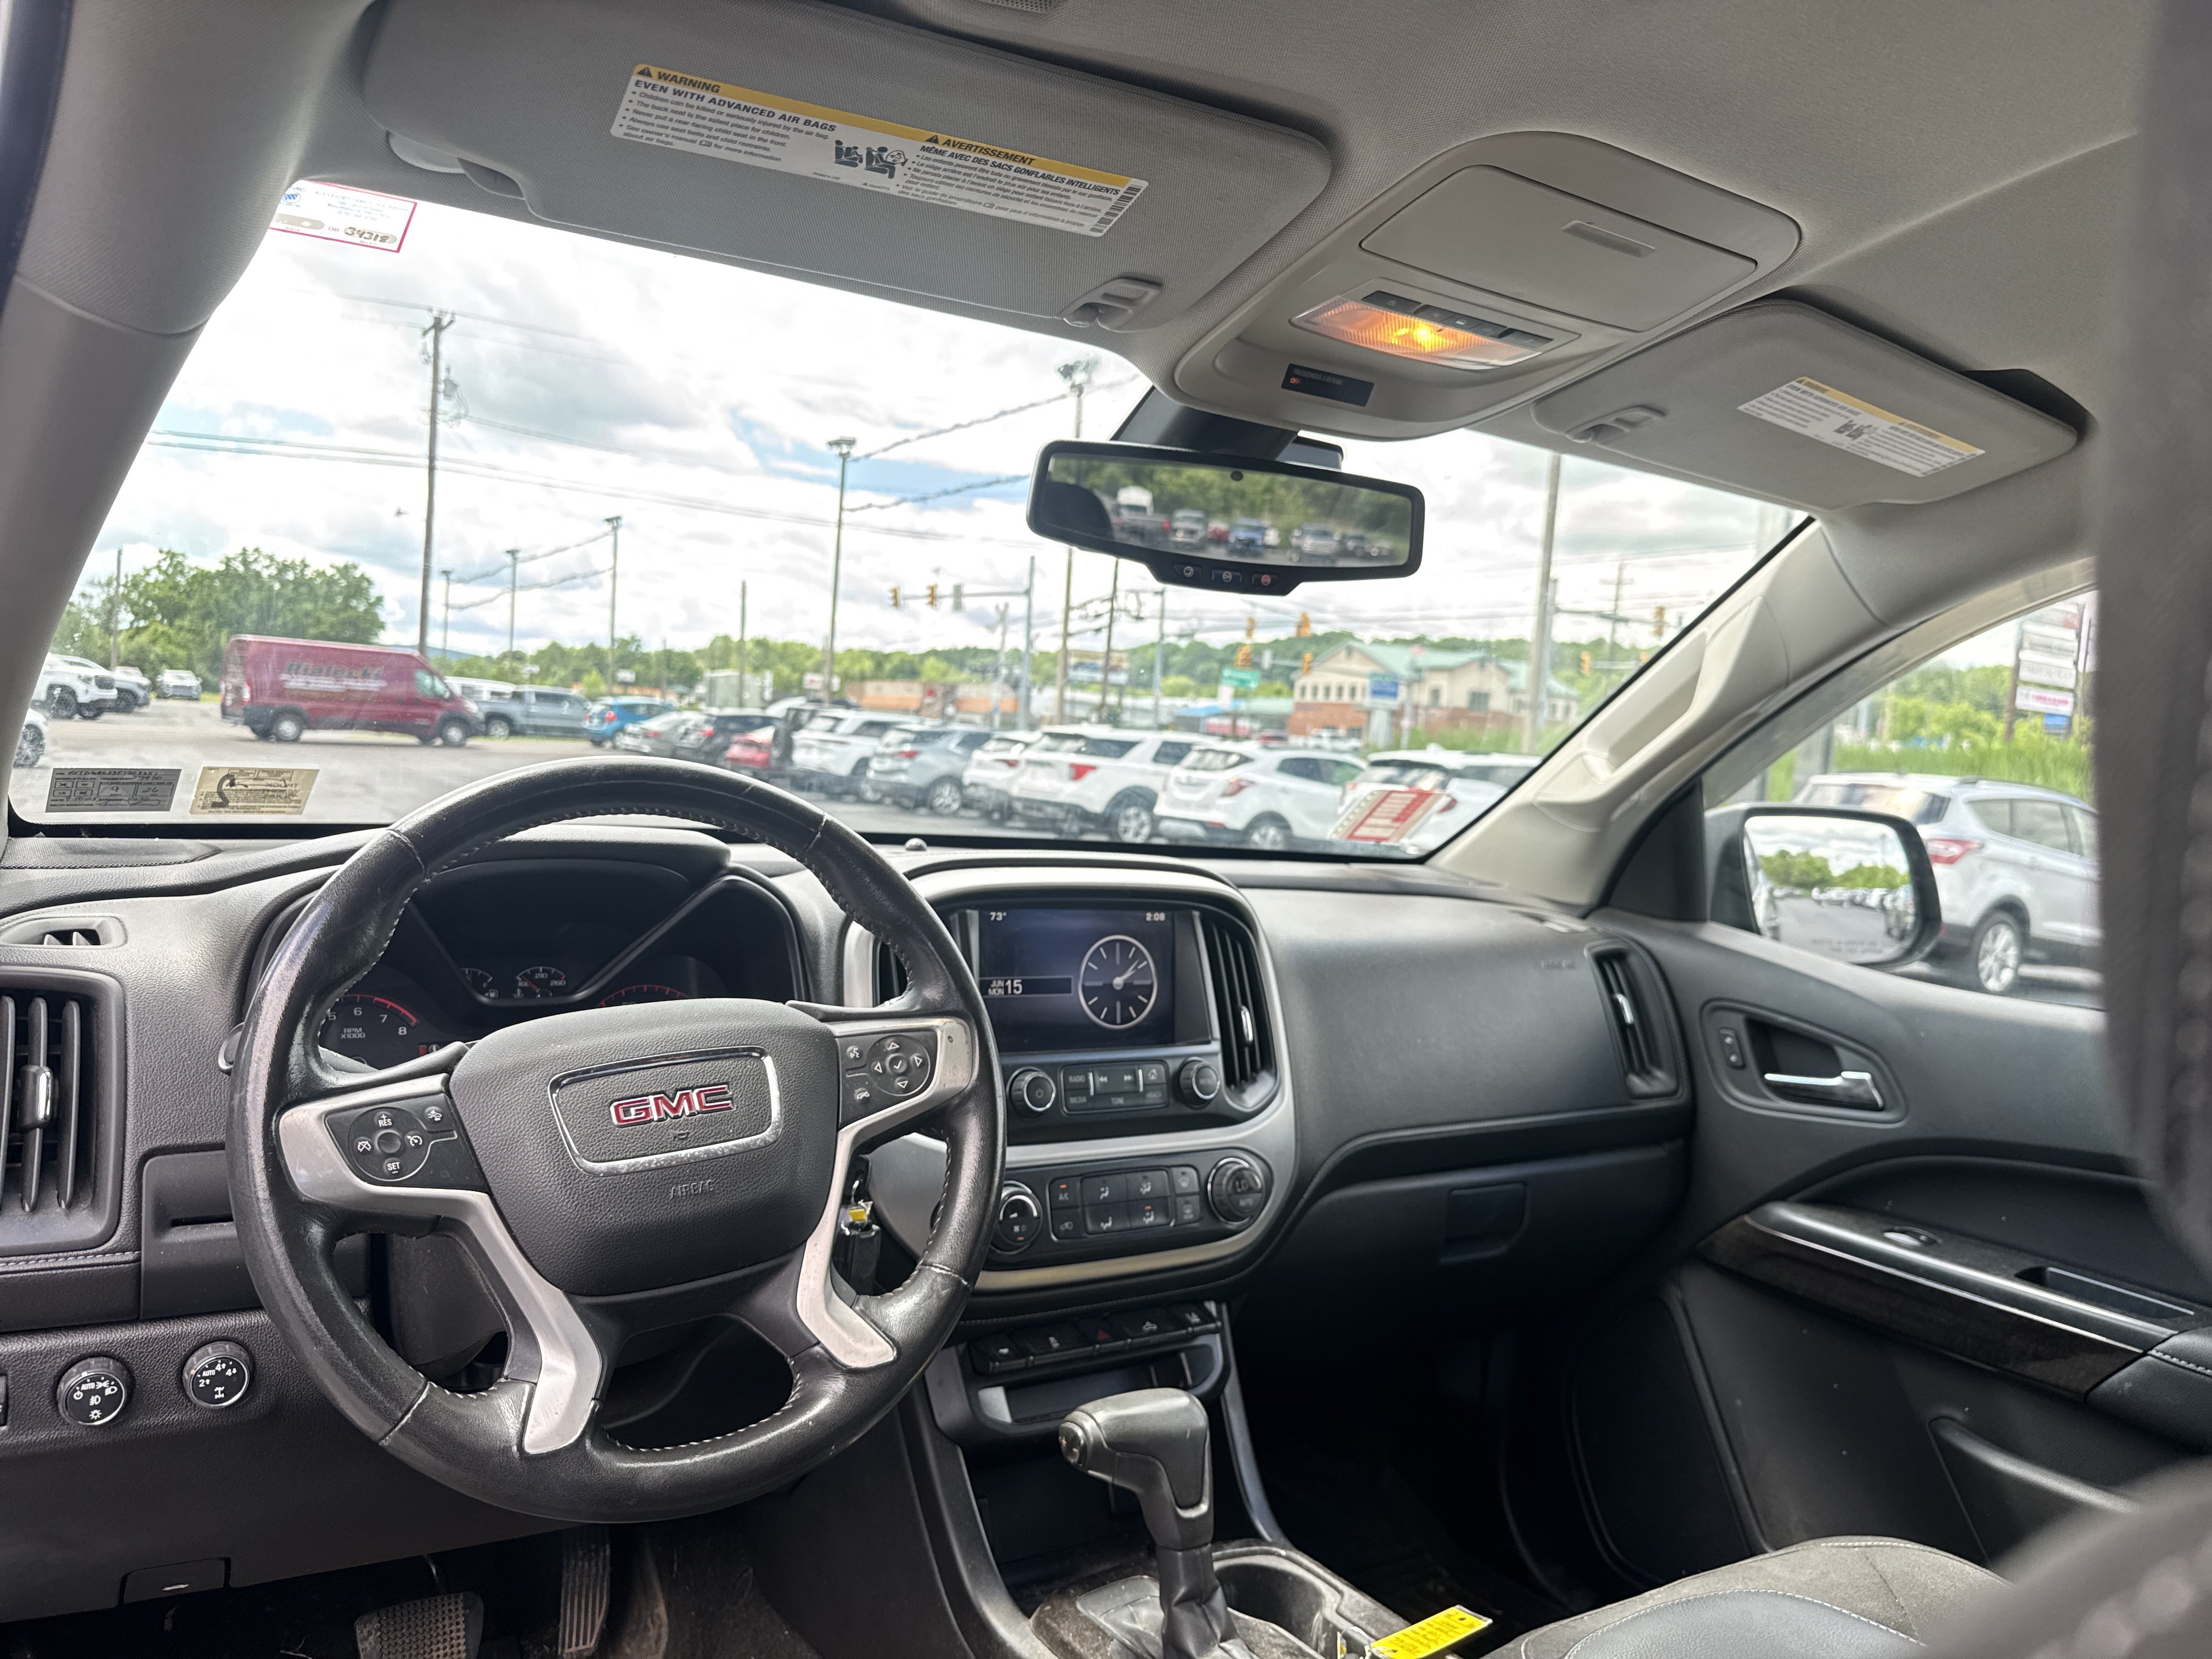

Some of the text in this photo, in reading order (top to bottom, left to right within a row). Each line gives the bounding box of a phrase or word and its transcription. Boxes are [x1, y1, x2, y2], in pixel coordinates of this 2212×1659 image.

[658, 71, 720, 93] WARNING
[635, 80, 836, 131] EVEN WITH ADVANCED AIR BAGS
[639, 92, 669, 103] Children
[696, 105, 716, 114] killed
[725, 113, 757, 123] seriously
[758, 120, 782, 128] injured
[633, 109, 654, 117] Never
[675, 119, 713, 131] rear-facing
[651, 104, 669, 112] back
[762, 130, 790, 139] children.
[629, 117, 655, 127] Always
[738, 142, 771, 151] restraints.
[641, 129, 670, 138] owner's
[672, 135, 697, 144] manual
[743, 150, 781, 161] information
[941, 139, 1036, 165] AVERTISSEMENT
[920, 146, 1120, 195] MÊME AVEC DES SACS GONFLABLES INTELLIGENTS
[345, 227, 390, 242] 34318
[990, 912, 1007, 921] 73°
[989, 988, 1005, 996] MON
[1005, 979, 1023, 995] 15
[328, 1007, 408, 1036] 5 6 7 8
[610, 1084, 737, 1128] GMC
[379, 1119, 392, 1127] RES
[387, 1161, 400, 1171] SET
[670, 1179, 714, 1199] AIRBAG
[202, 1369, 216, 1377] AUTO
[215, 1363, 221, 1372] 4
[225, 1368, 232, 1376] 4
[81, 1381, 95, 1391] AUTO
[199, 1379, 206, 1387] 2
